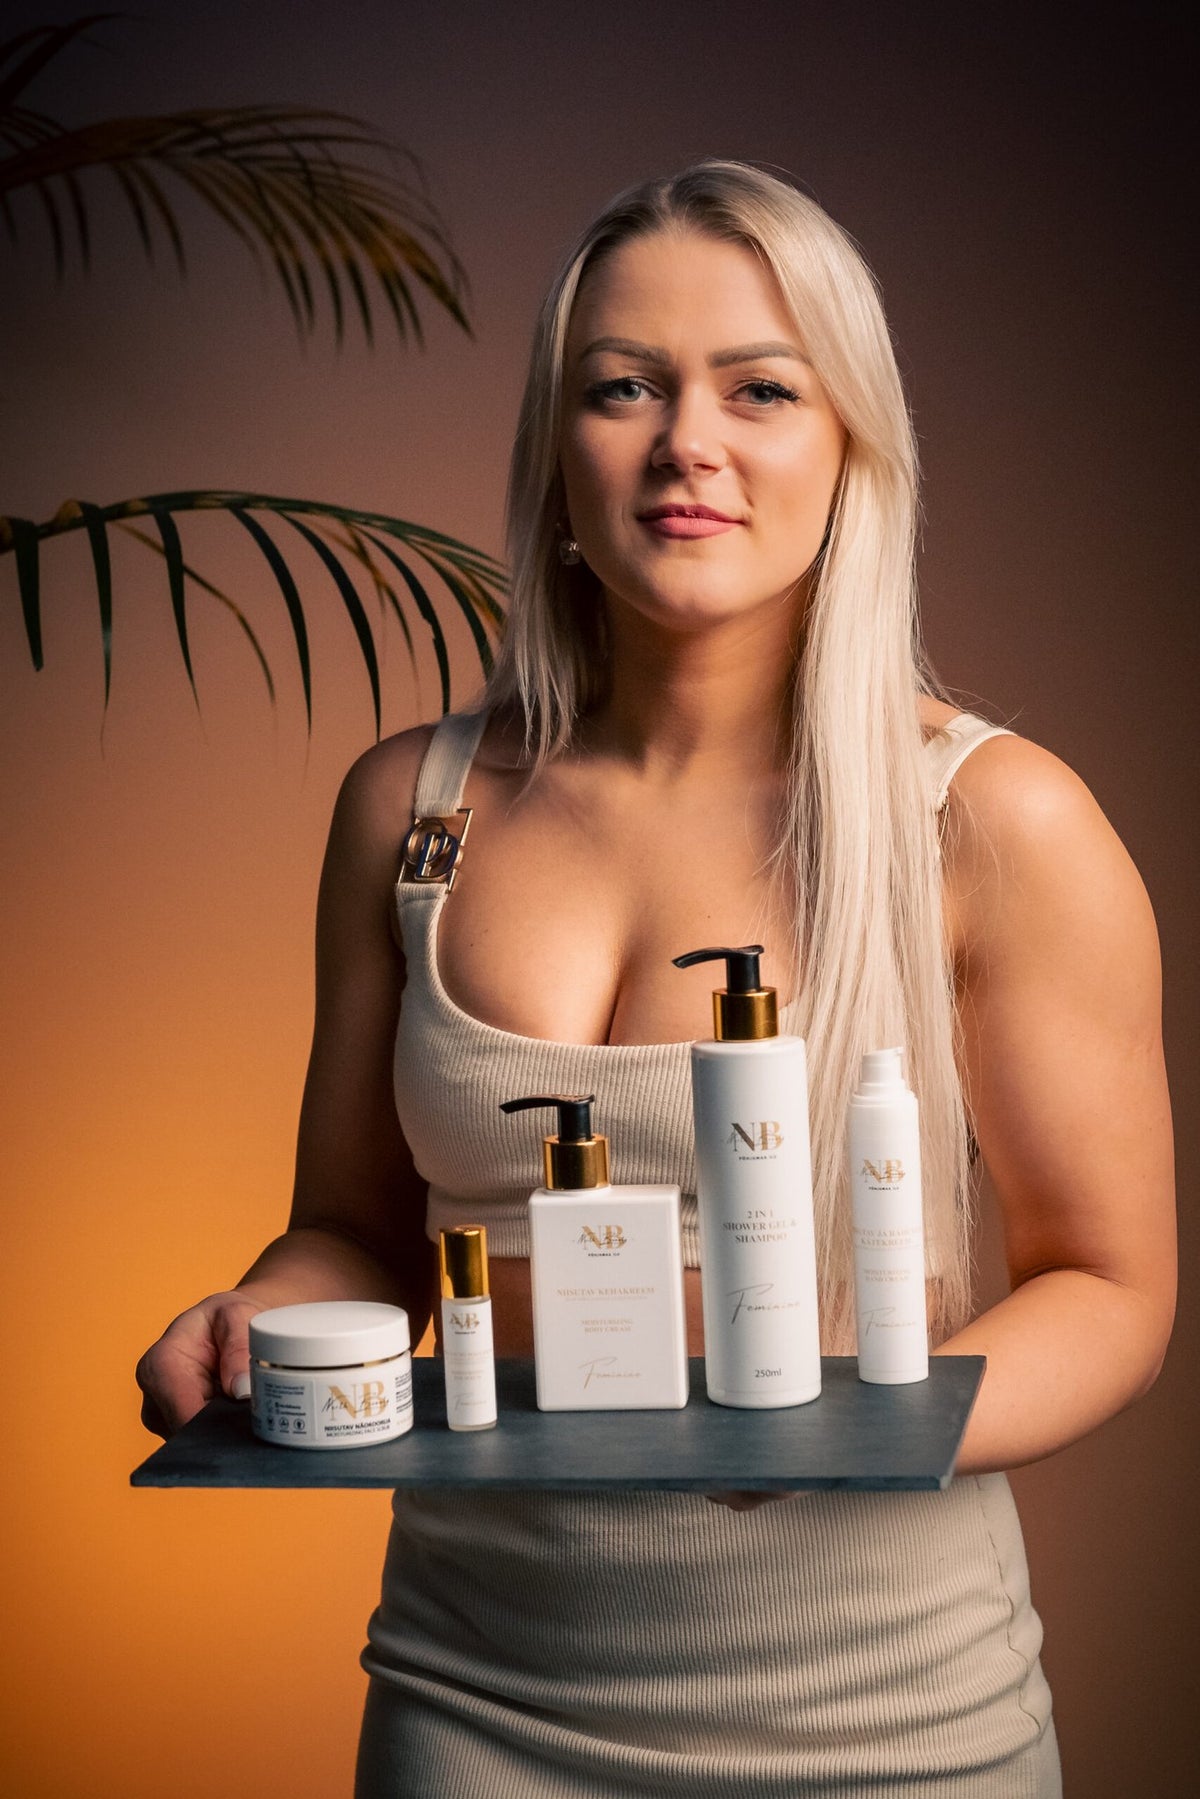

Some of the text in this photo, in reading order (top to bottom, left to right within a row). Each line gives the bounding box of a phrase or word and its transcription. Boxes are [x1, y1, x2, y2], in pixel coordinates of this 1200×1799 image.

[731, 1121, 784, 1152] NB
[747, 1210, 752, 1218] 2
[755, 1210, 766, 1218] IN
[722, 1222, 766, 1231] SHOWER
[735, 1232, 788, 1243] SHAMPOO
[755, 1368, 782, 1378] 250ml
